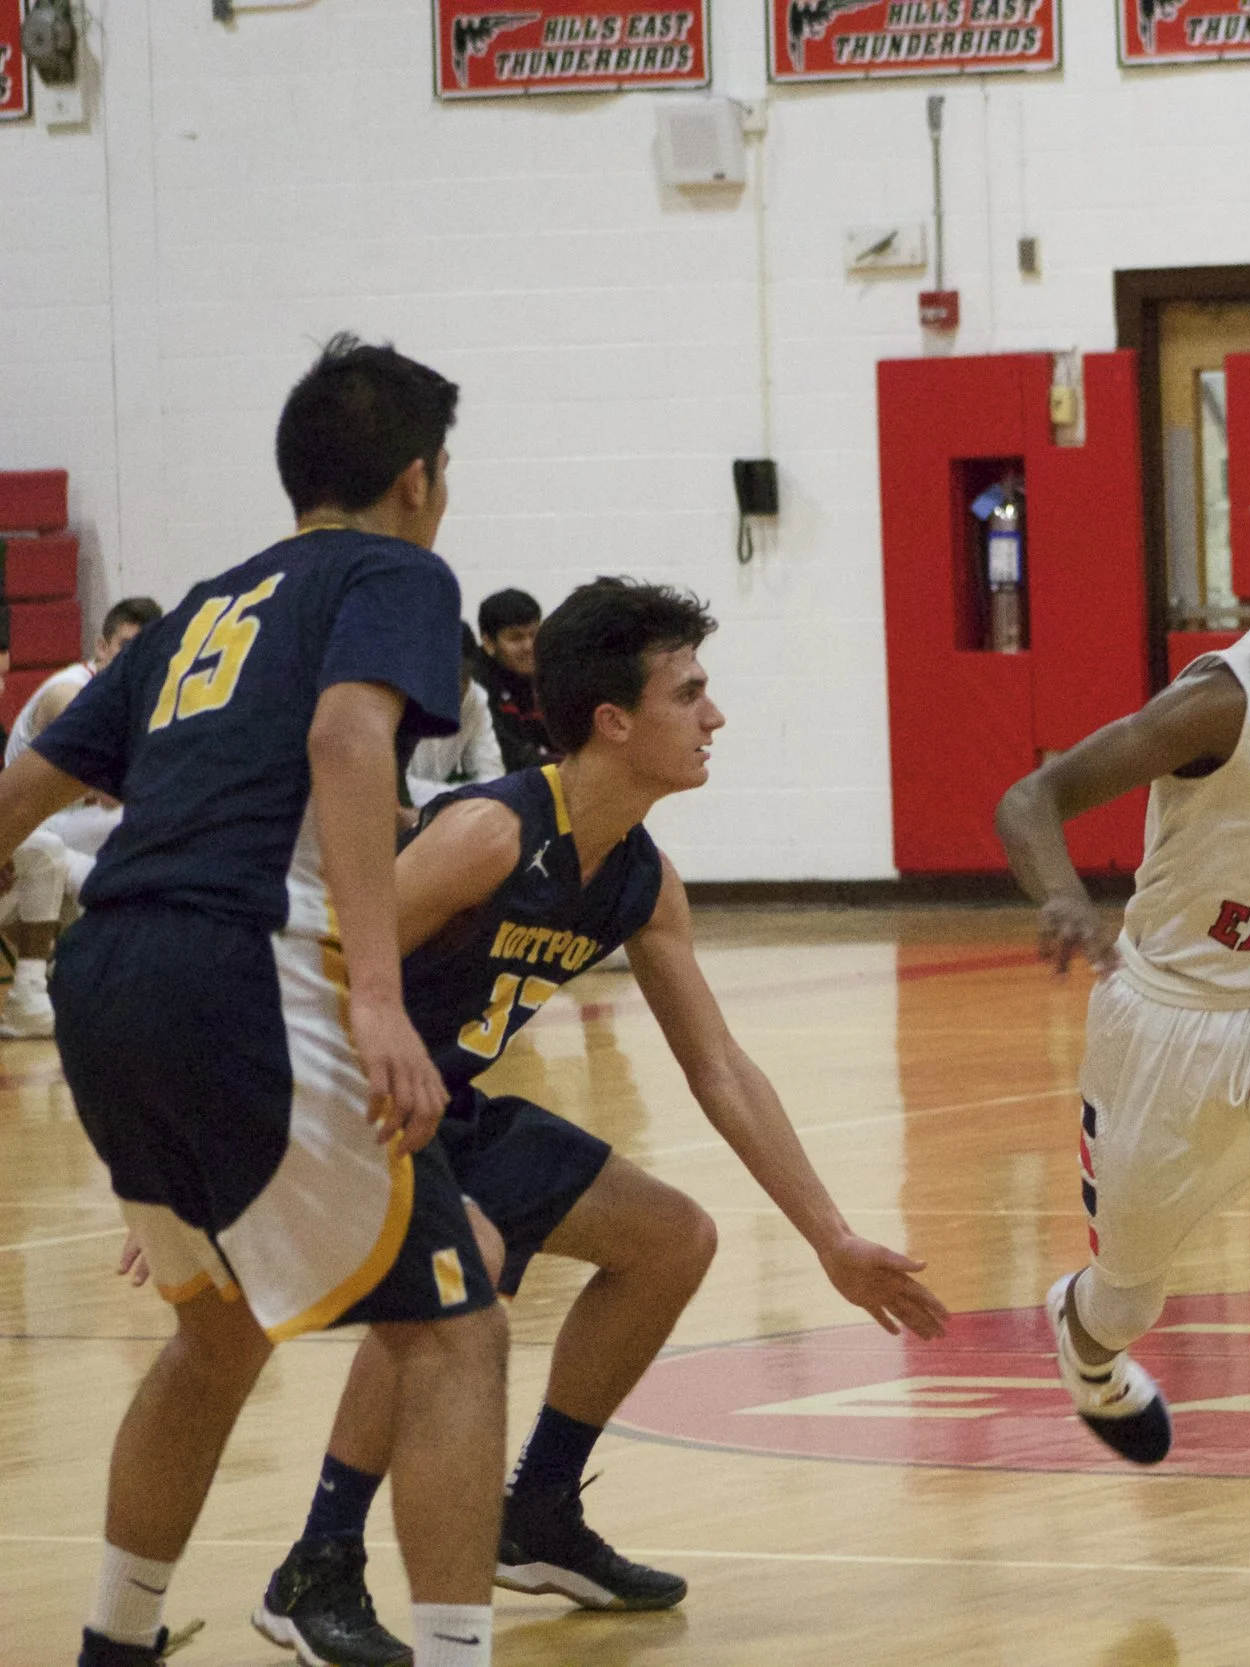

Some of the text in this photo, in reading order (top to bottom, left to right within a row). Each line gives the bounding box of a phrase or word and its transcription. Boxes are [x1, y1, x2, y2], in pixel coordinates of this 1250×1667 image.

[543, 12, 694, 46] HILLS EAST
[885, 0, 1044, 28] HILLS EAST
[496, 43, 695, 80] THUNDERBIRDS
[834, 26, 1043, 64] THUNDERBIRDS
[148, 572, 286, 734] 15
